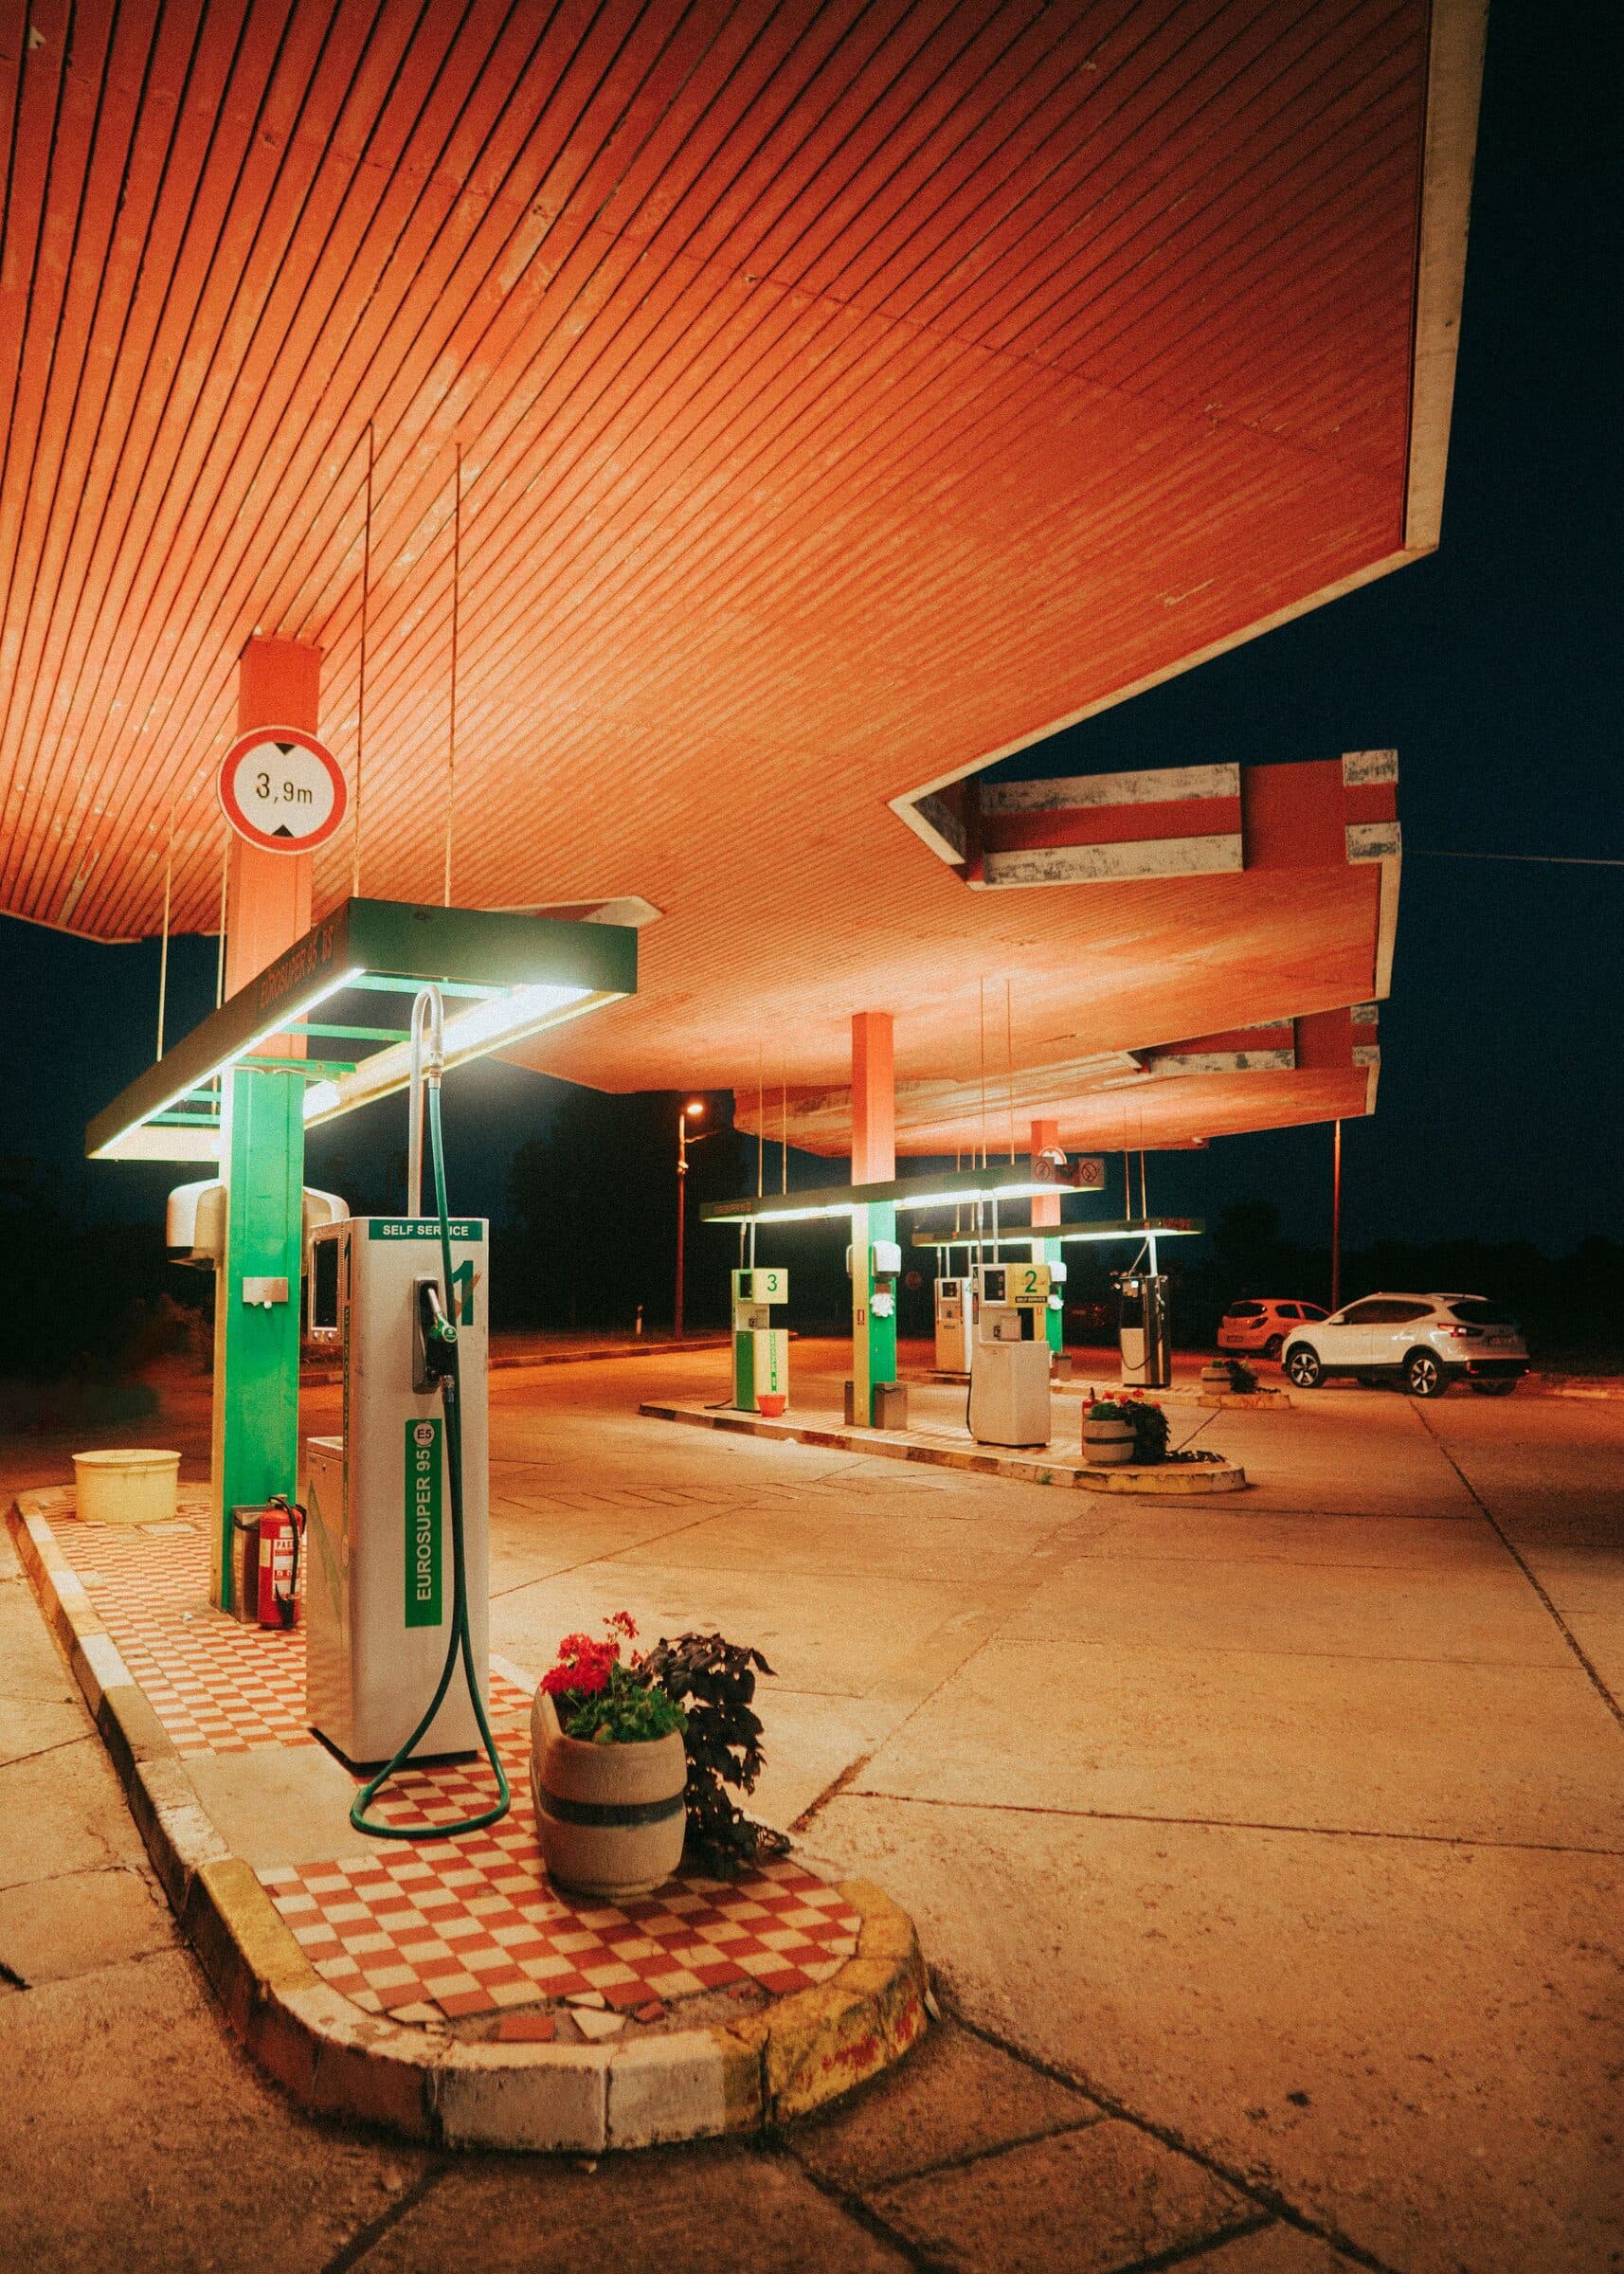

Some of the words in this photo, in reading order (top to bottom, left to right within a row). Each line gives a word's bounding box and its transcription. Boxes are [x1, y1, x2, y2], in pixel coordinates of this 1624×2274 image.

[256, 772, 313, 803] 3,9m
[383, 1224, 414, 1236] SELF
[417, 1225, 469, 1236] SERICE
[453, 1260, 474, 1326] 1
[767, 1273, 778, 1291] 3
[1024, 1270, 1038, 1293] 2
[417, 1429, 432, 1439] E5
[416, 1449, 431, 1472] 95
[416, 1475, 432, 1601] EUROSUPER
